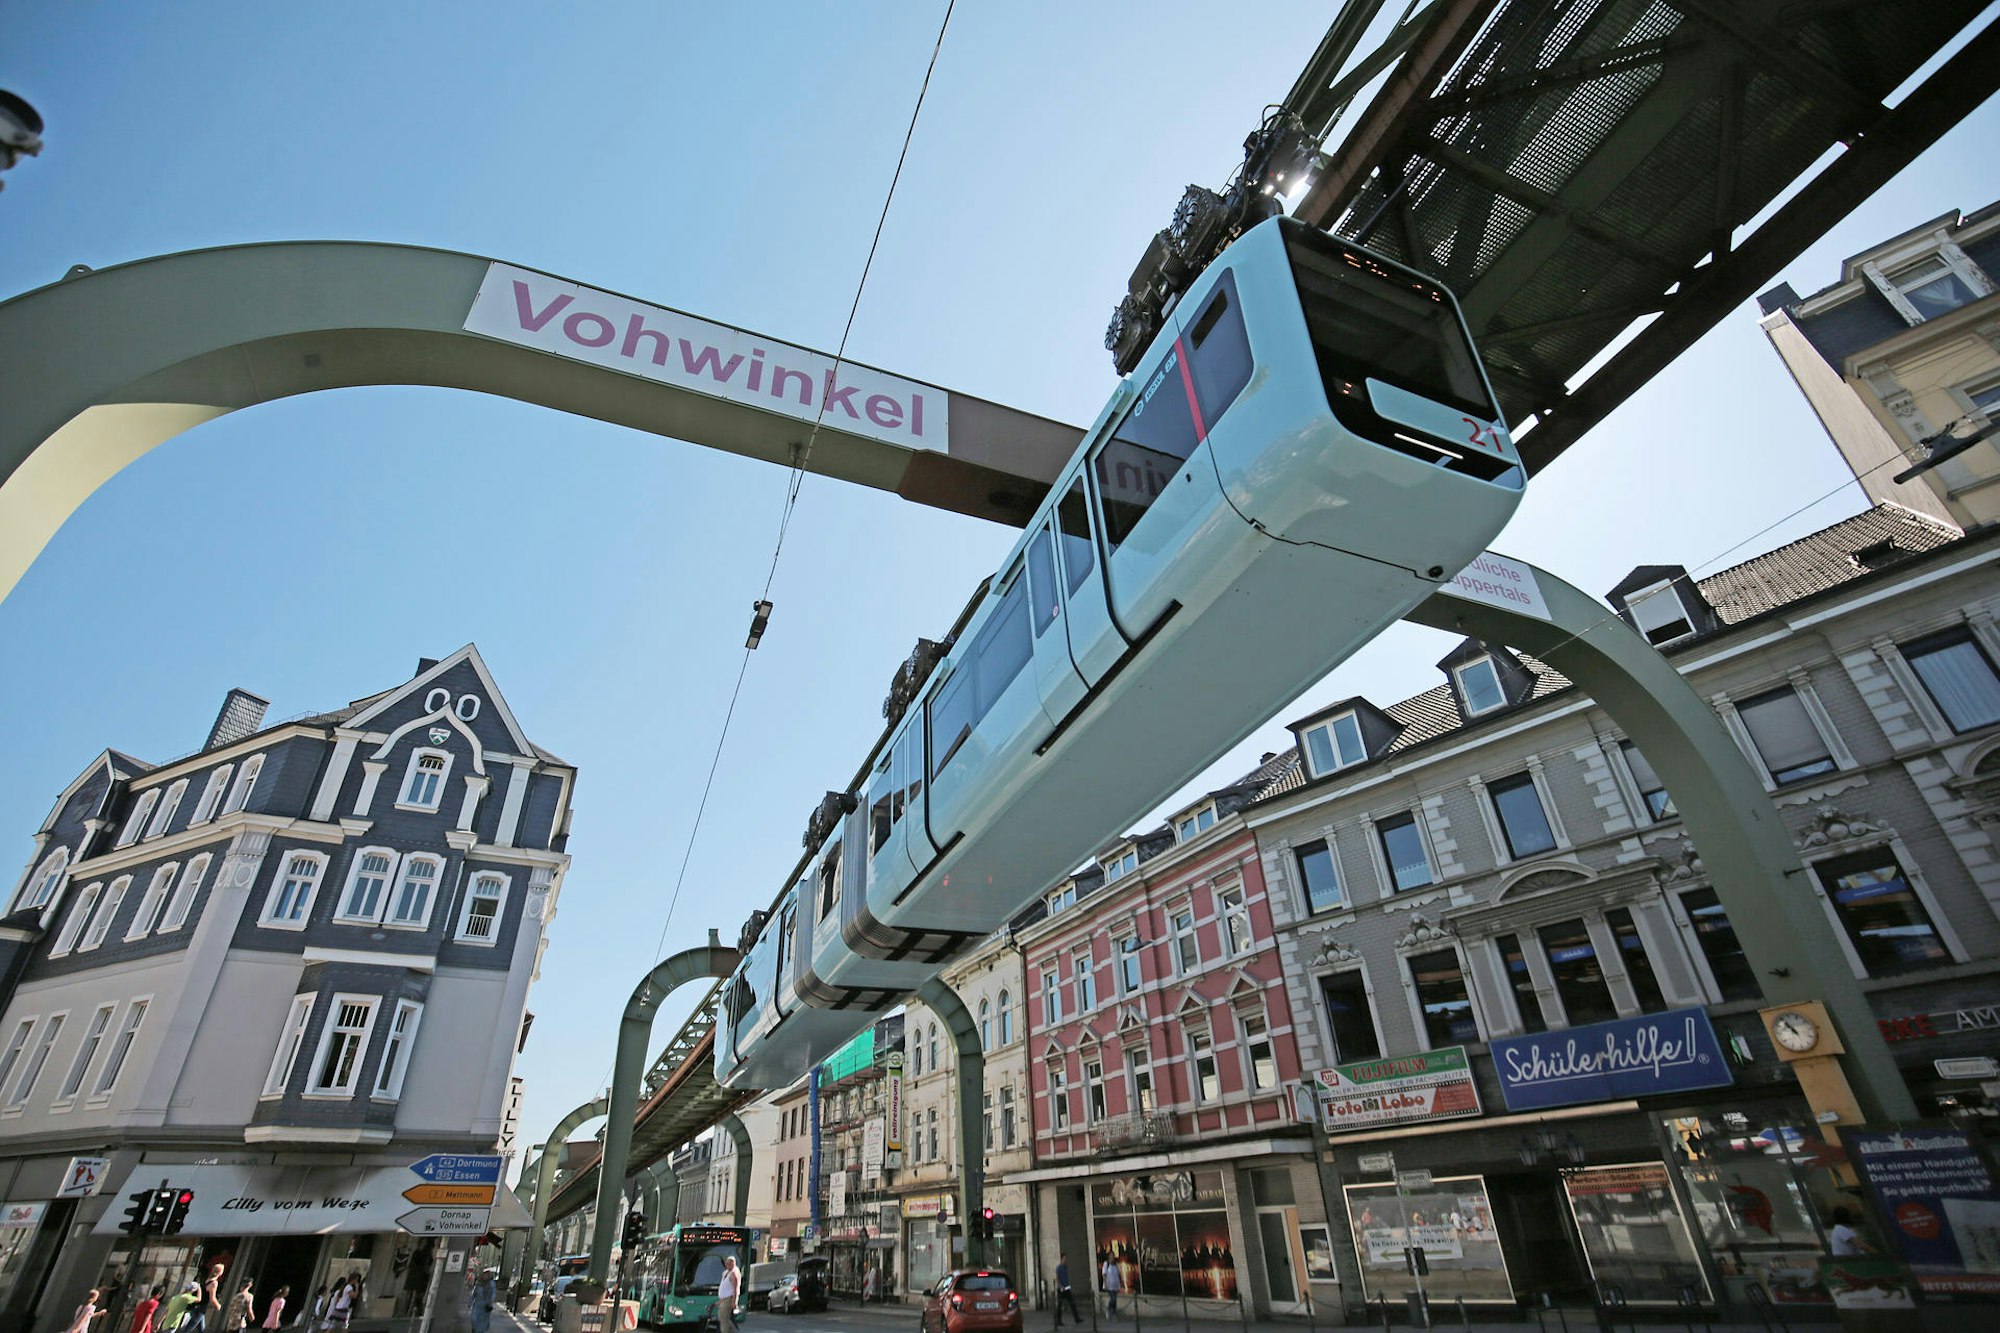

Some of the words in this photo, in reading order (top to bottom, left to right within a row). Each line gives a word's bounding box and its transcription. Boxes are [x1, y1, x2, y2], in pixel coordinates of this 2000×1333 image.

[512, 280, 923, 437] Vohwinkel
[1462, 418, 1502, 452] 21
[1352, 1057, 1427, 1081] FUJIFILM
[1327, 1100, 1363, 1117] Foto
[1381, 1093, 1425, 1111] Lobo
[501, 1084, 522, 1147] LILLY
[456, 1159, 498, 1168] Dortmund
[454, 1171, 480, 1180] Essen
[221, 1198, 265, 1212] Lilly
[273, 1200, 312, 1210] vom
[321, 1197, 370, 1211] Wege
[441, 1210, 471, 1219] Dornap
[440, 1221, 482, 1230] Vohwinkel
